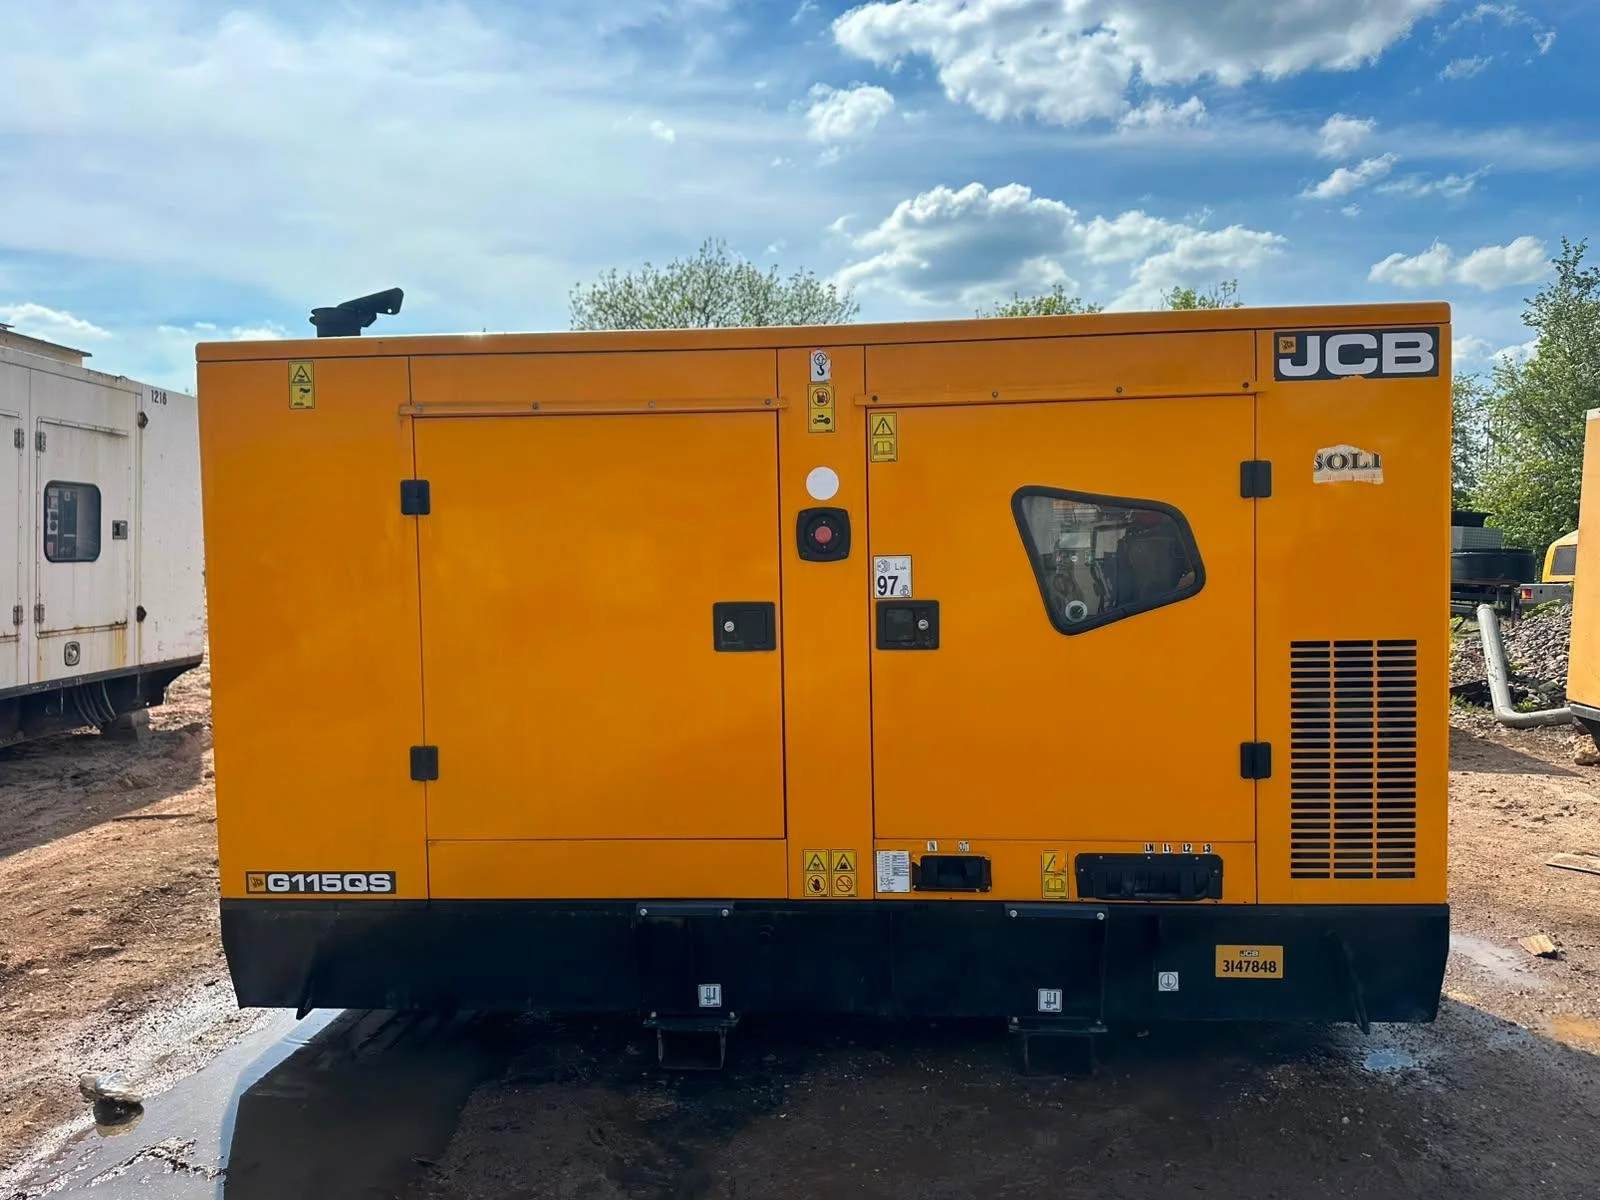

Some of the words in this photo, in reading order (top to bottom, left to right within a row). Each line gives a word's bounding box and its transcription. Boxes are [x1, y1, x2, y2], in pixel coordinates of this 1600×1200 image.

[1278, 332, 1435, 377] JCB
[877, 575, 898, 596] 97
[1183, 844, 1191, 853] L2
[267, 873, 391, 892] G115QS
[1222, 960, 1277, 973] 3147848
